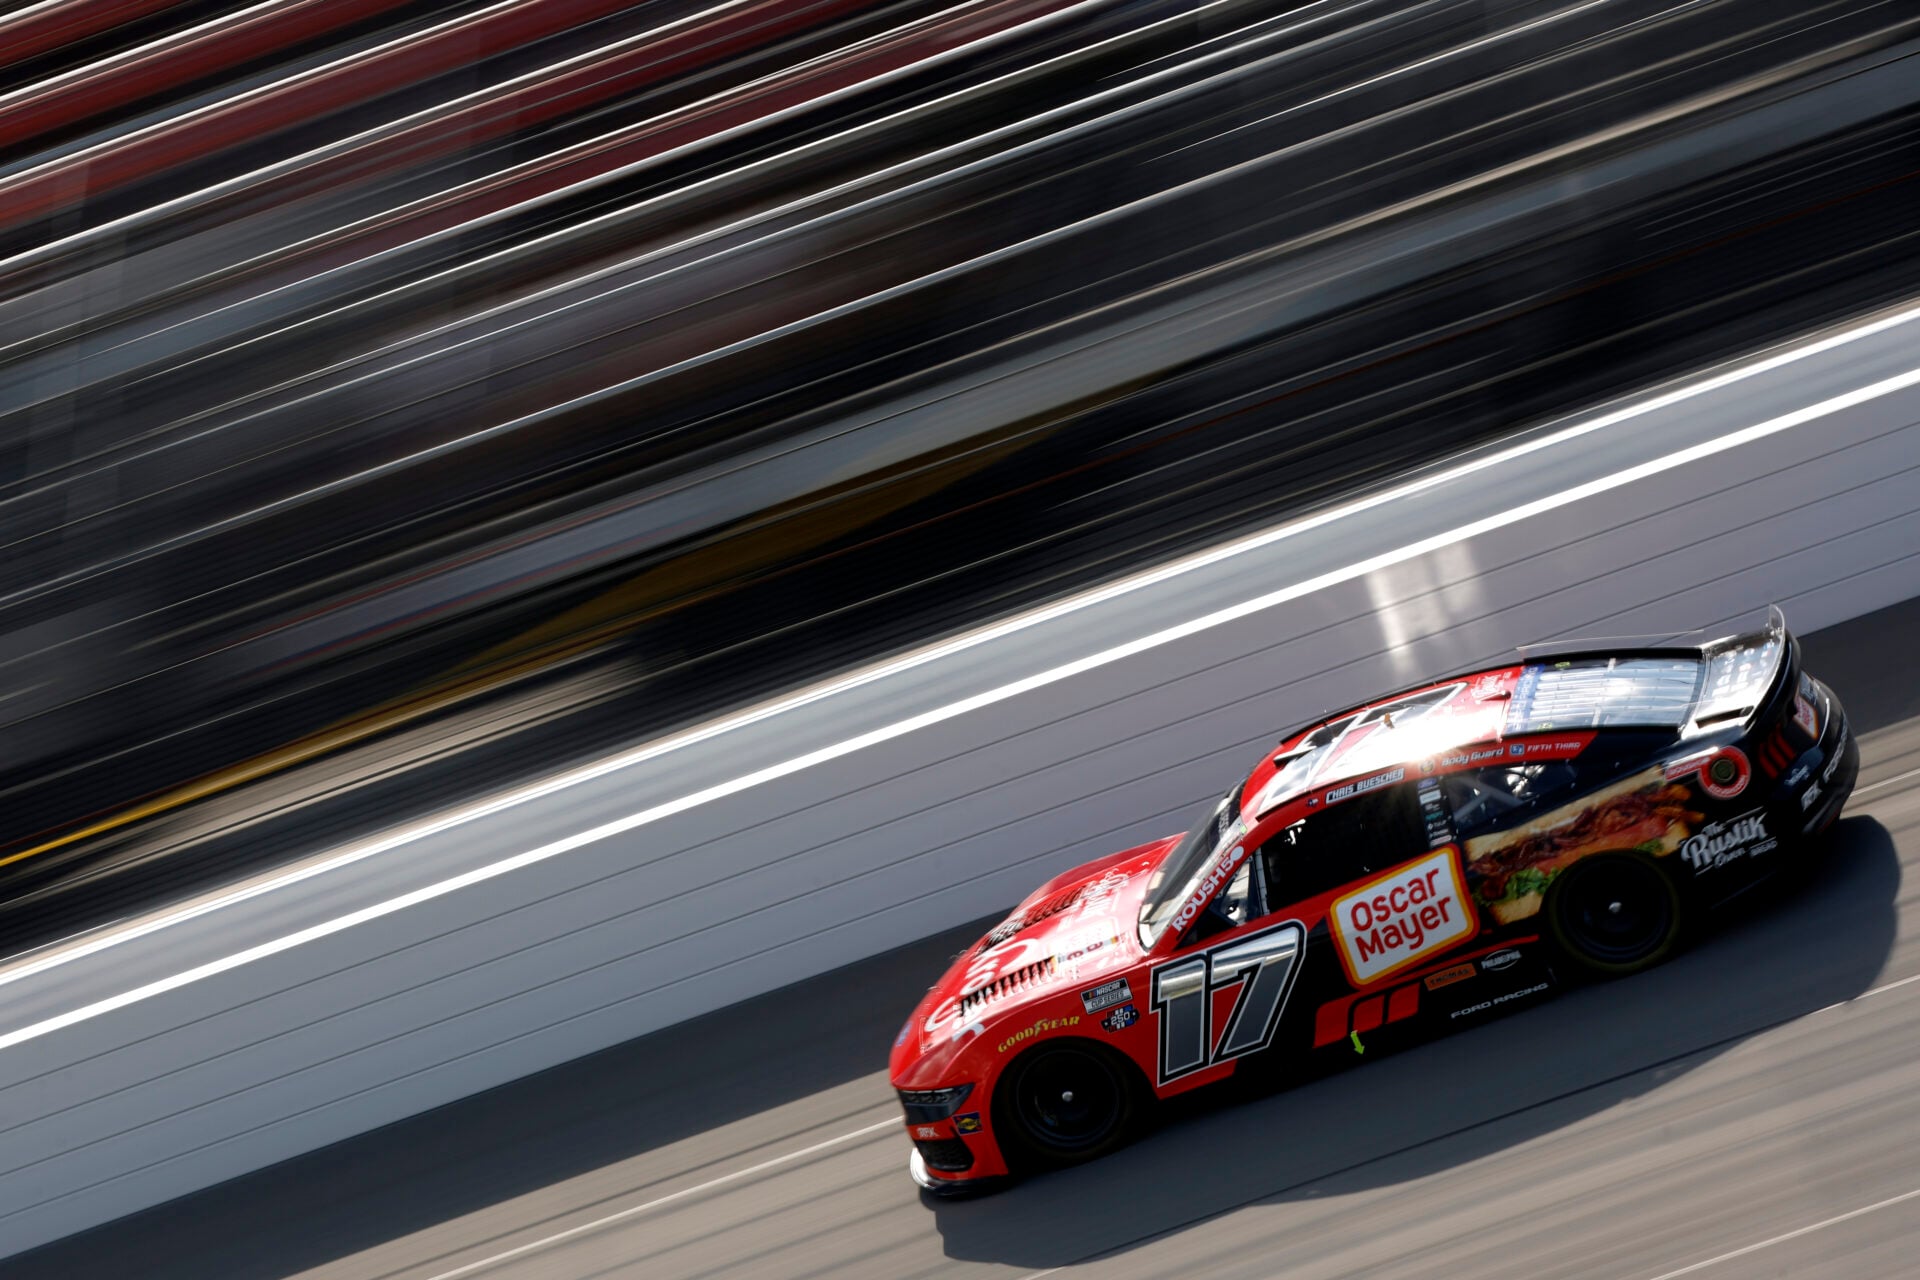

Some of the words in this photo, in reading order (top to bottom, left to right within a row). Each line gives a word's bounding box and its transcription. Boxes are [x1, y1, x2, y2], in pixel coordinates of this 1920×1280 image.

[1441, 755, 1469, 767] Body
[1471, 748, 1504, 762] Guard
[1527, 743, 1552, 753] FIFTH
[1554, 742, 1582, 751] THIRD
[1326, 784, 1354, 804] CHRIS
[1356, 767, 1404, 792] BUESCHER
[1350, 868, 1439, 931] Oscar
[1355, 897, 1451, 962] Mayer
[1096, 982, 1120, 997] NASCAR
[1151, 920, 1306, 1086] 17
[1450, 1001, 1492, 1019] FORD
[1493, 982, 1549, 1005] RACING
[998, 1016, 1080, 1053] GOODYEAR
[1110, 1011, 1130, 1026] 250
